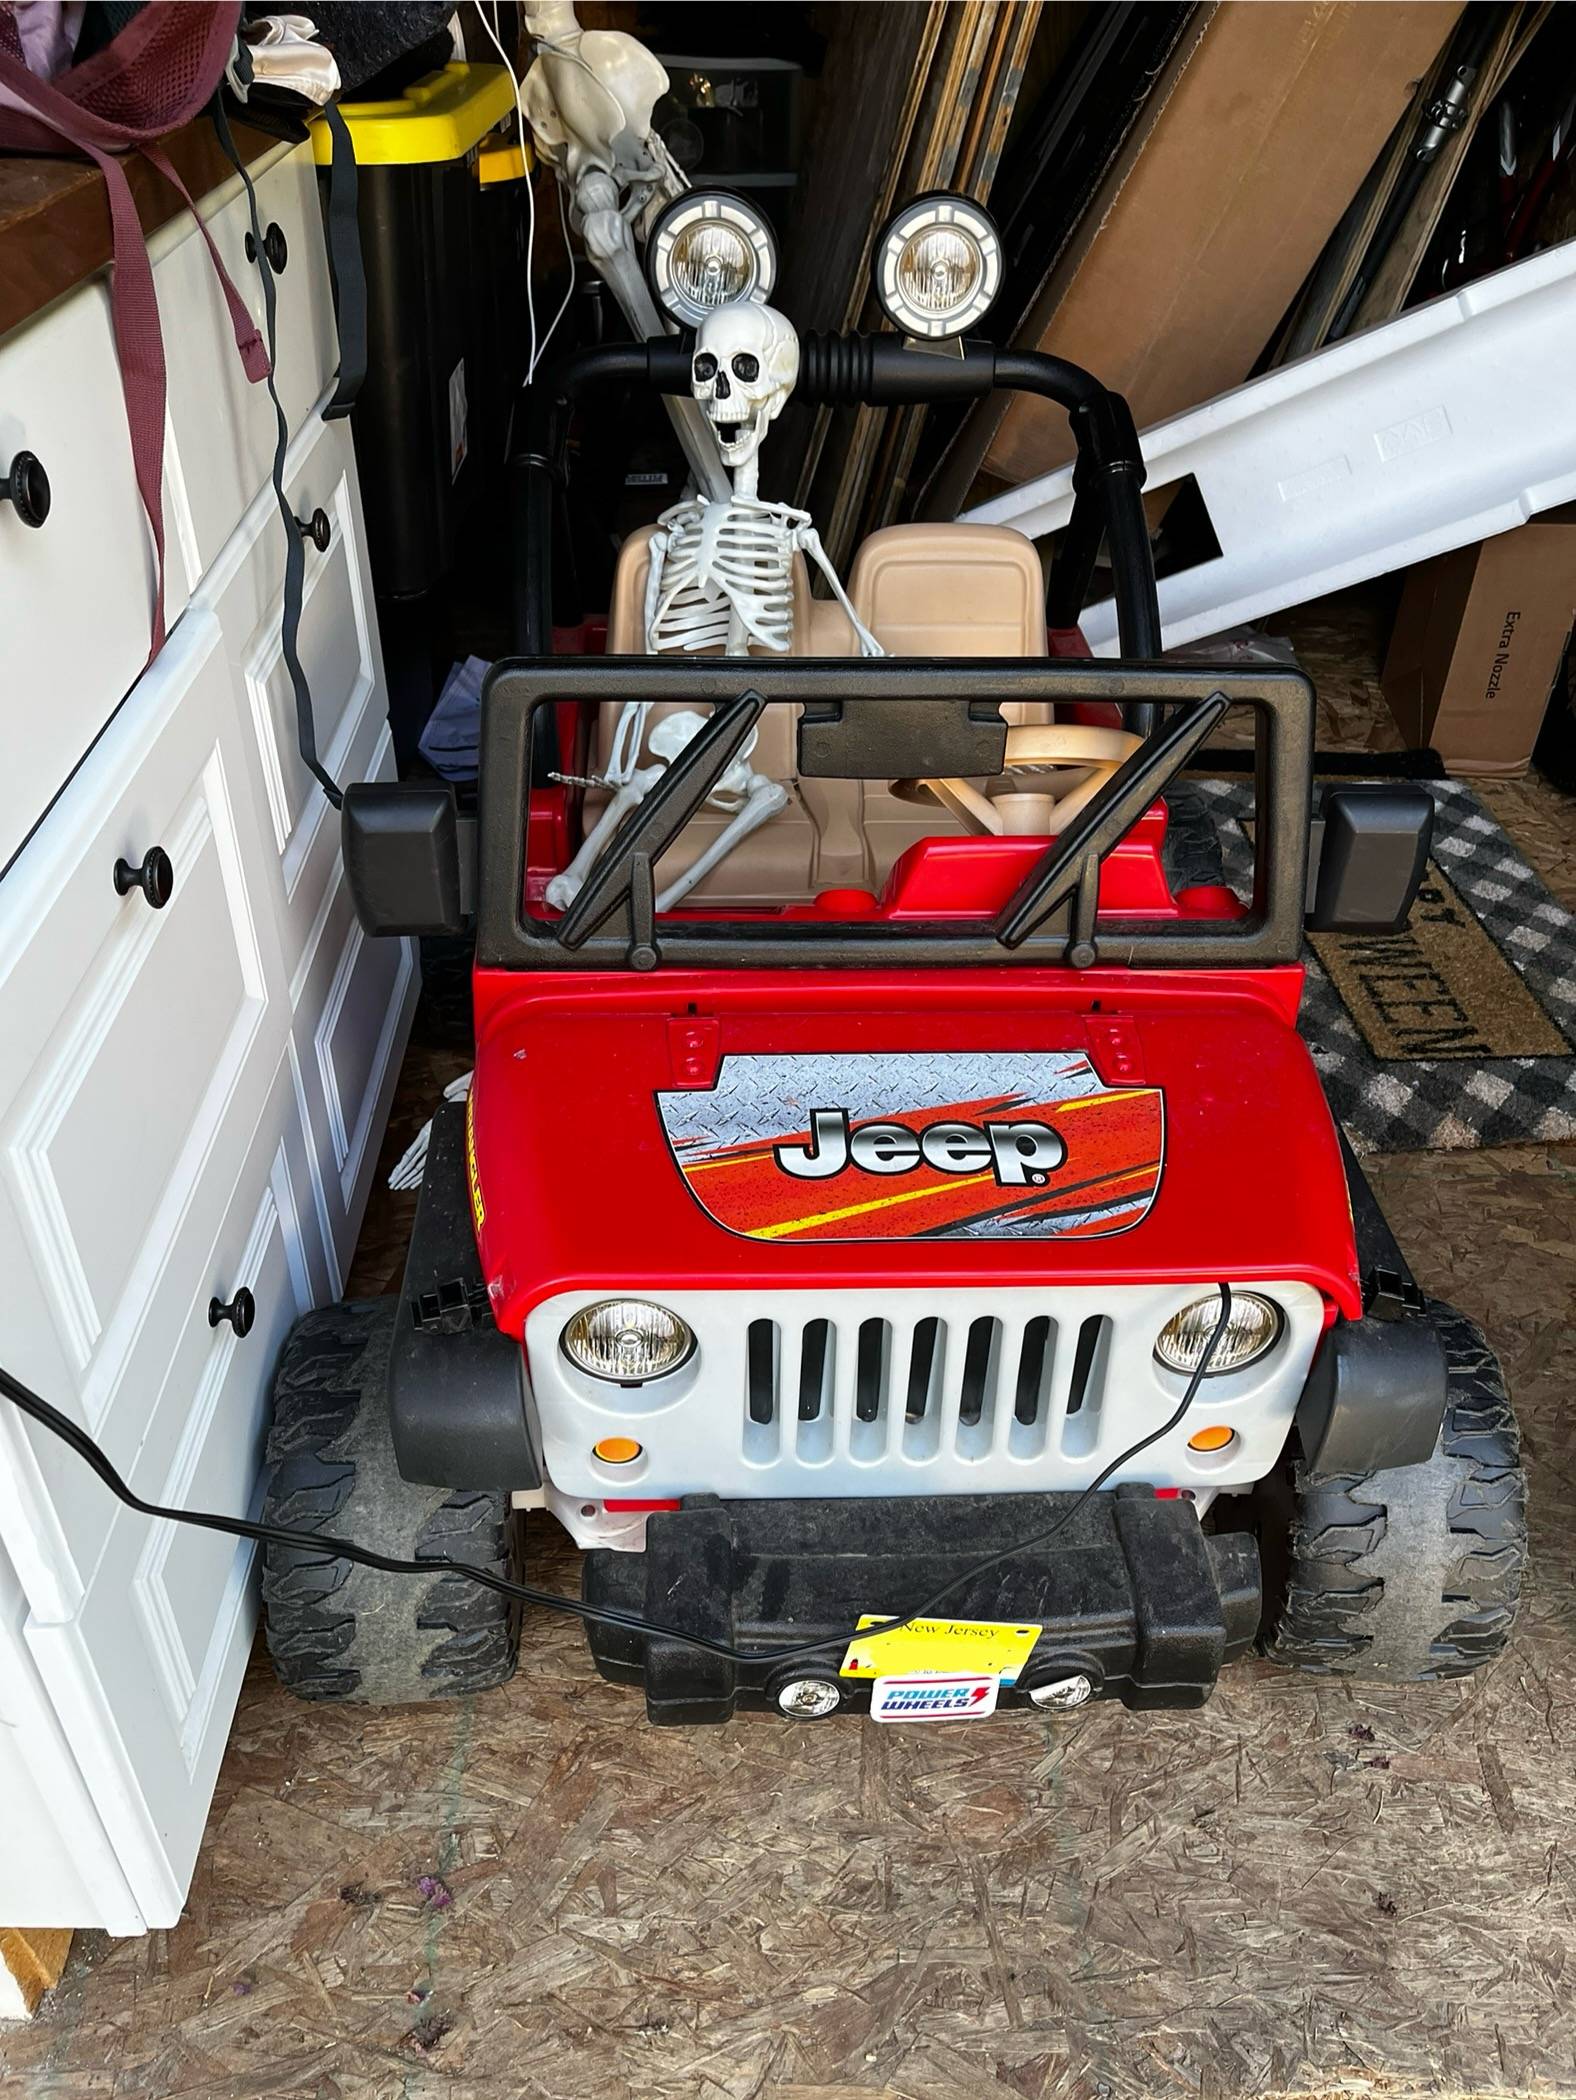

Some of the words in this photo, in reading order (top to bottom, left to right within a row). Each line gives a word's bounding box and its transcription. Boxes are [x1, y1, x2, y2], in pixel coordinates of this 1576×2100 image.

[1499, 611, 1521, 649] Extra
[1485, 653, 1510, 699] Nozzle
[1338, 925, 1492, 1053] WEEN
[772, 1108, 1067, 1187] Jeep
[900, 1622, 940, 1634] New
[944, 1624, 1000, 1639] Jersey
[881, 1698, 970, 1710] WHEELS
[887, 1688, 970, 1700] POWER
